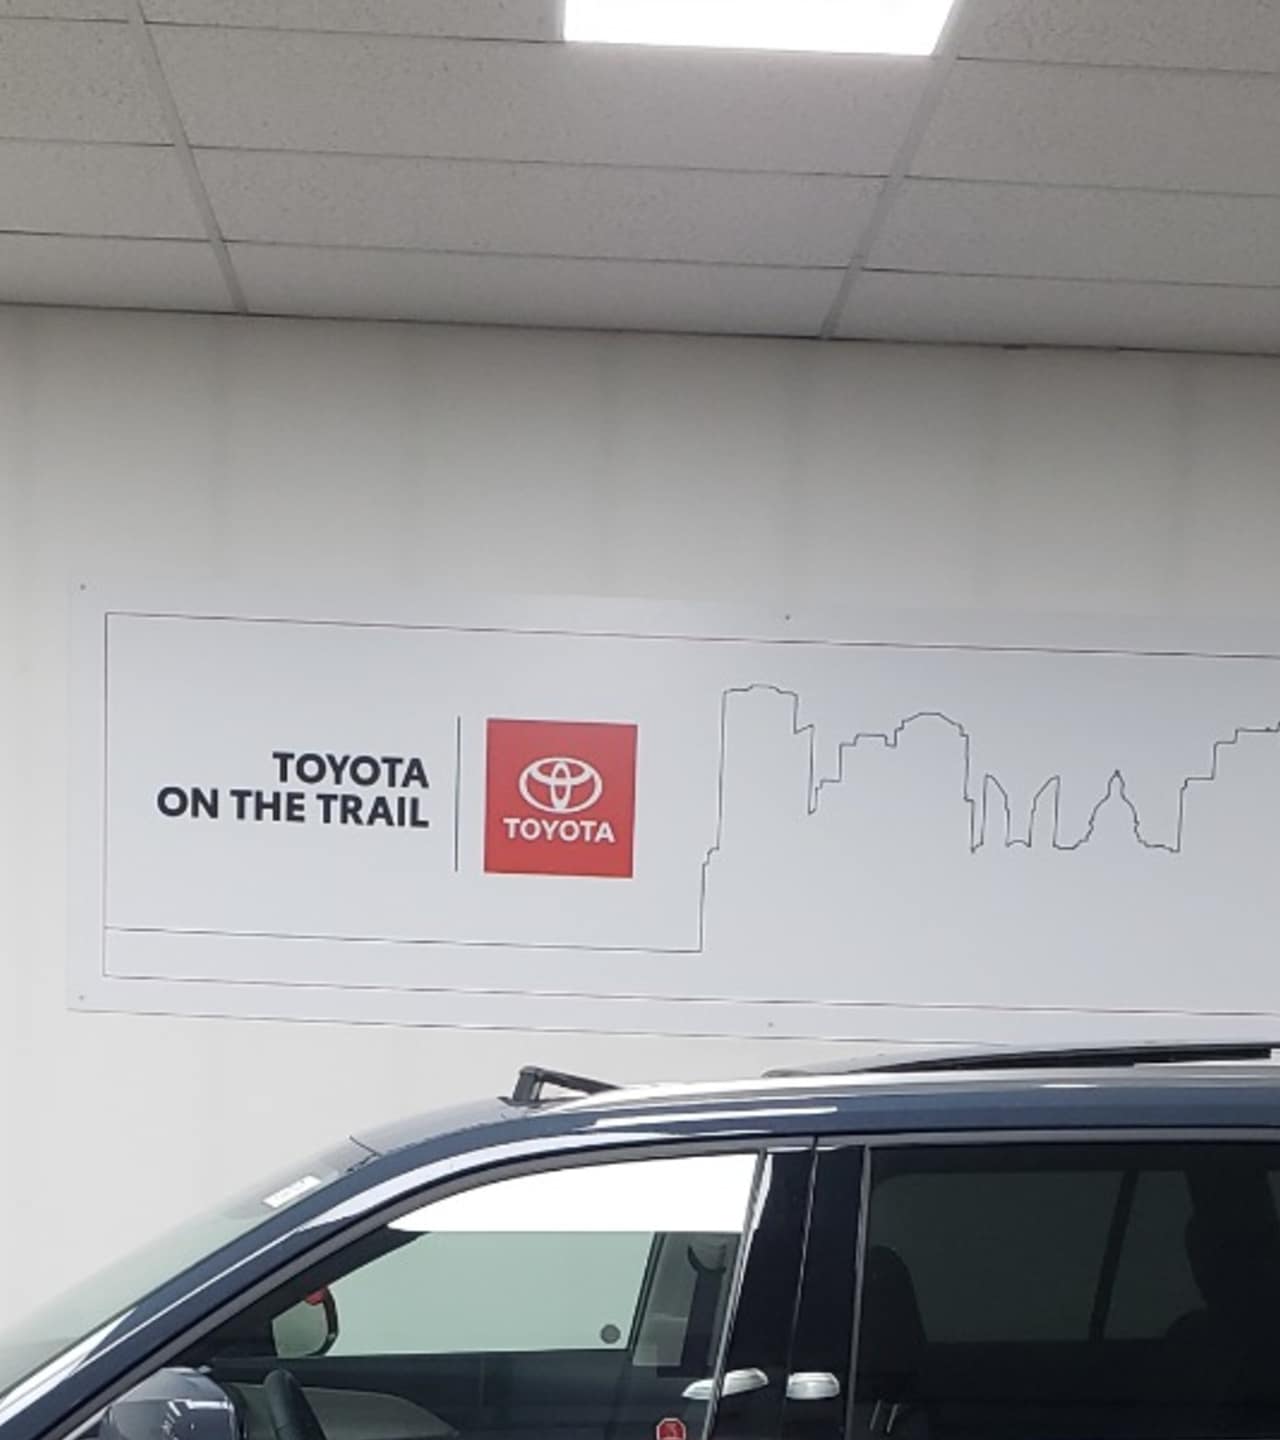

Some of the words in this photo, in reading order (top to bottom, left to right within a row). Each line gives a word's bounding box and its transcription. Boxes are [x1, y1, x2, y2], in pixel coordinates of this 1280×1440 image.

[272, 750, 430, 789] TOYOTA
[156, 786, 219, 819] ON
[229, 789, 306, 823] THE
[315, 793, 430, 829] TRAIL
[502, 816, 615, 844] TOYOTA
